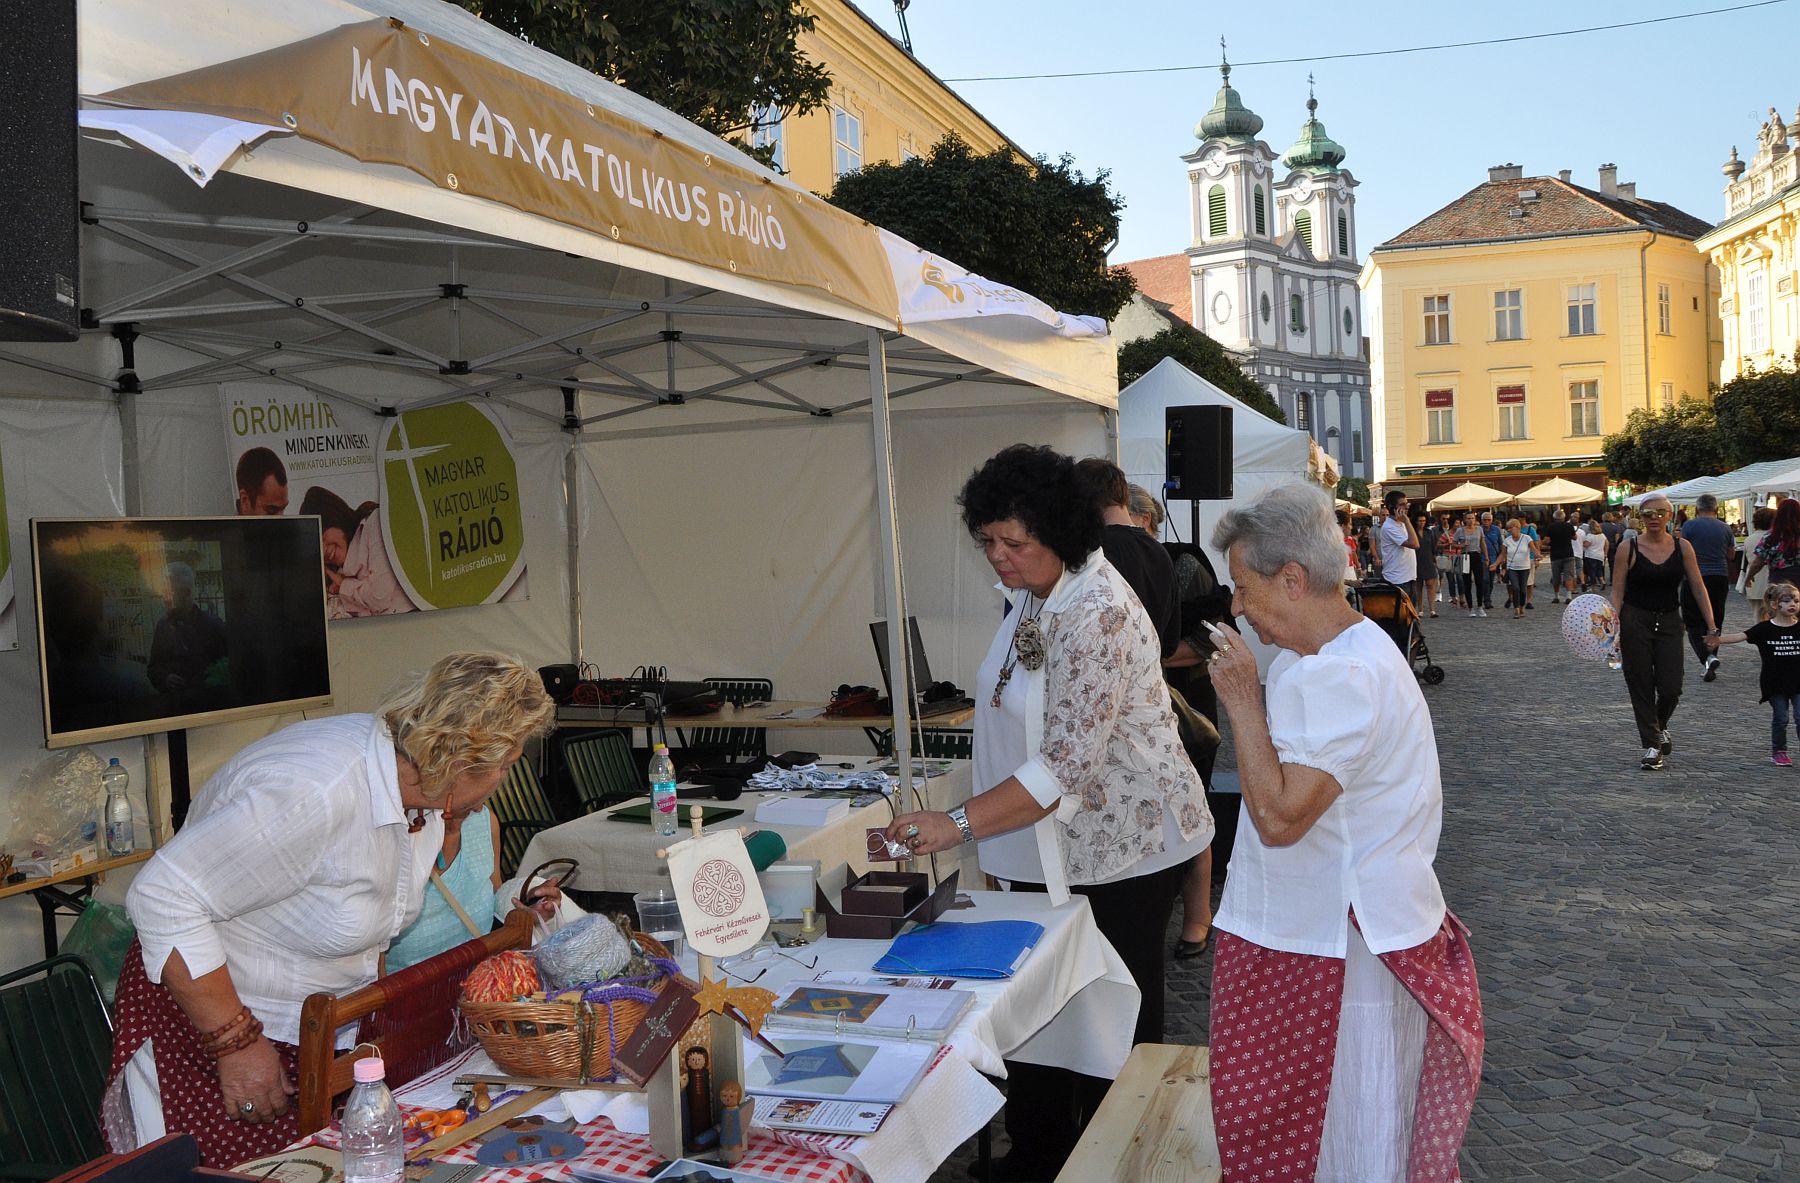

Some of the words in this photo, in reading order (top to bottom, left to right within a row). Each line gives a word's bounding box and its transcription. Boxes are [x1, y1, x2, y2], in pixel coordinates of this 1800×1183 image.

[351, 46, 532, 164] MAGYAR
[529, 127, 711, 227] KATOLIKUS
[232, 395, 338, 436] ÖRÖMHÍR
[285, 434, 370, 456] MINDENKINEK!
[424, 456, 487, 487] MAGYAR
[433, 482, 510, 520] KATOLIKUS
[439, 507, 504, 562] RÁDIÓ
[441, 553, 507, 580] katolikusradio.hu
[694, 922, 725, 939] Fehérvári
[726, 912, 762, 930] Kézművesek
[714, 928, 749, 944] Egyesülete
